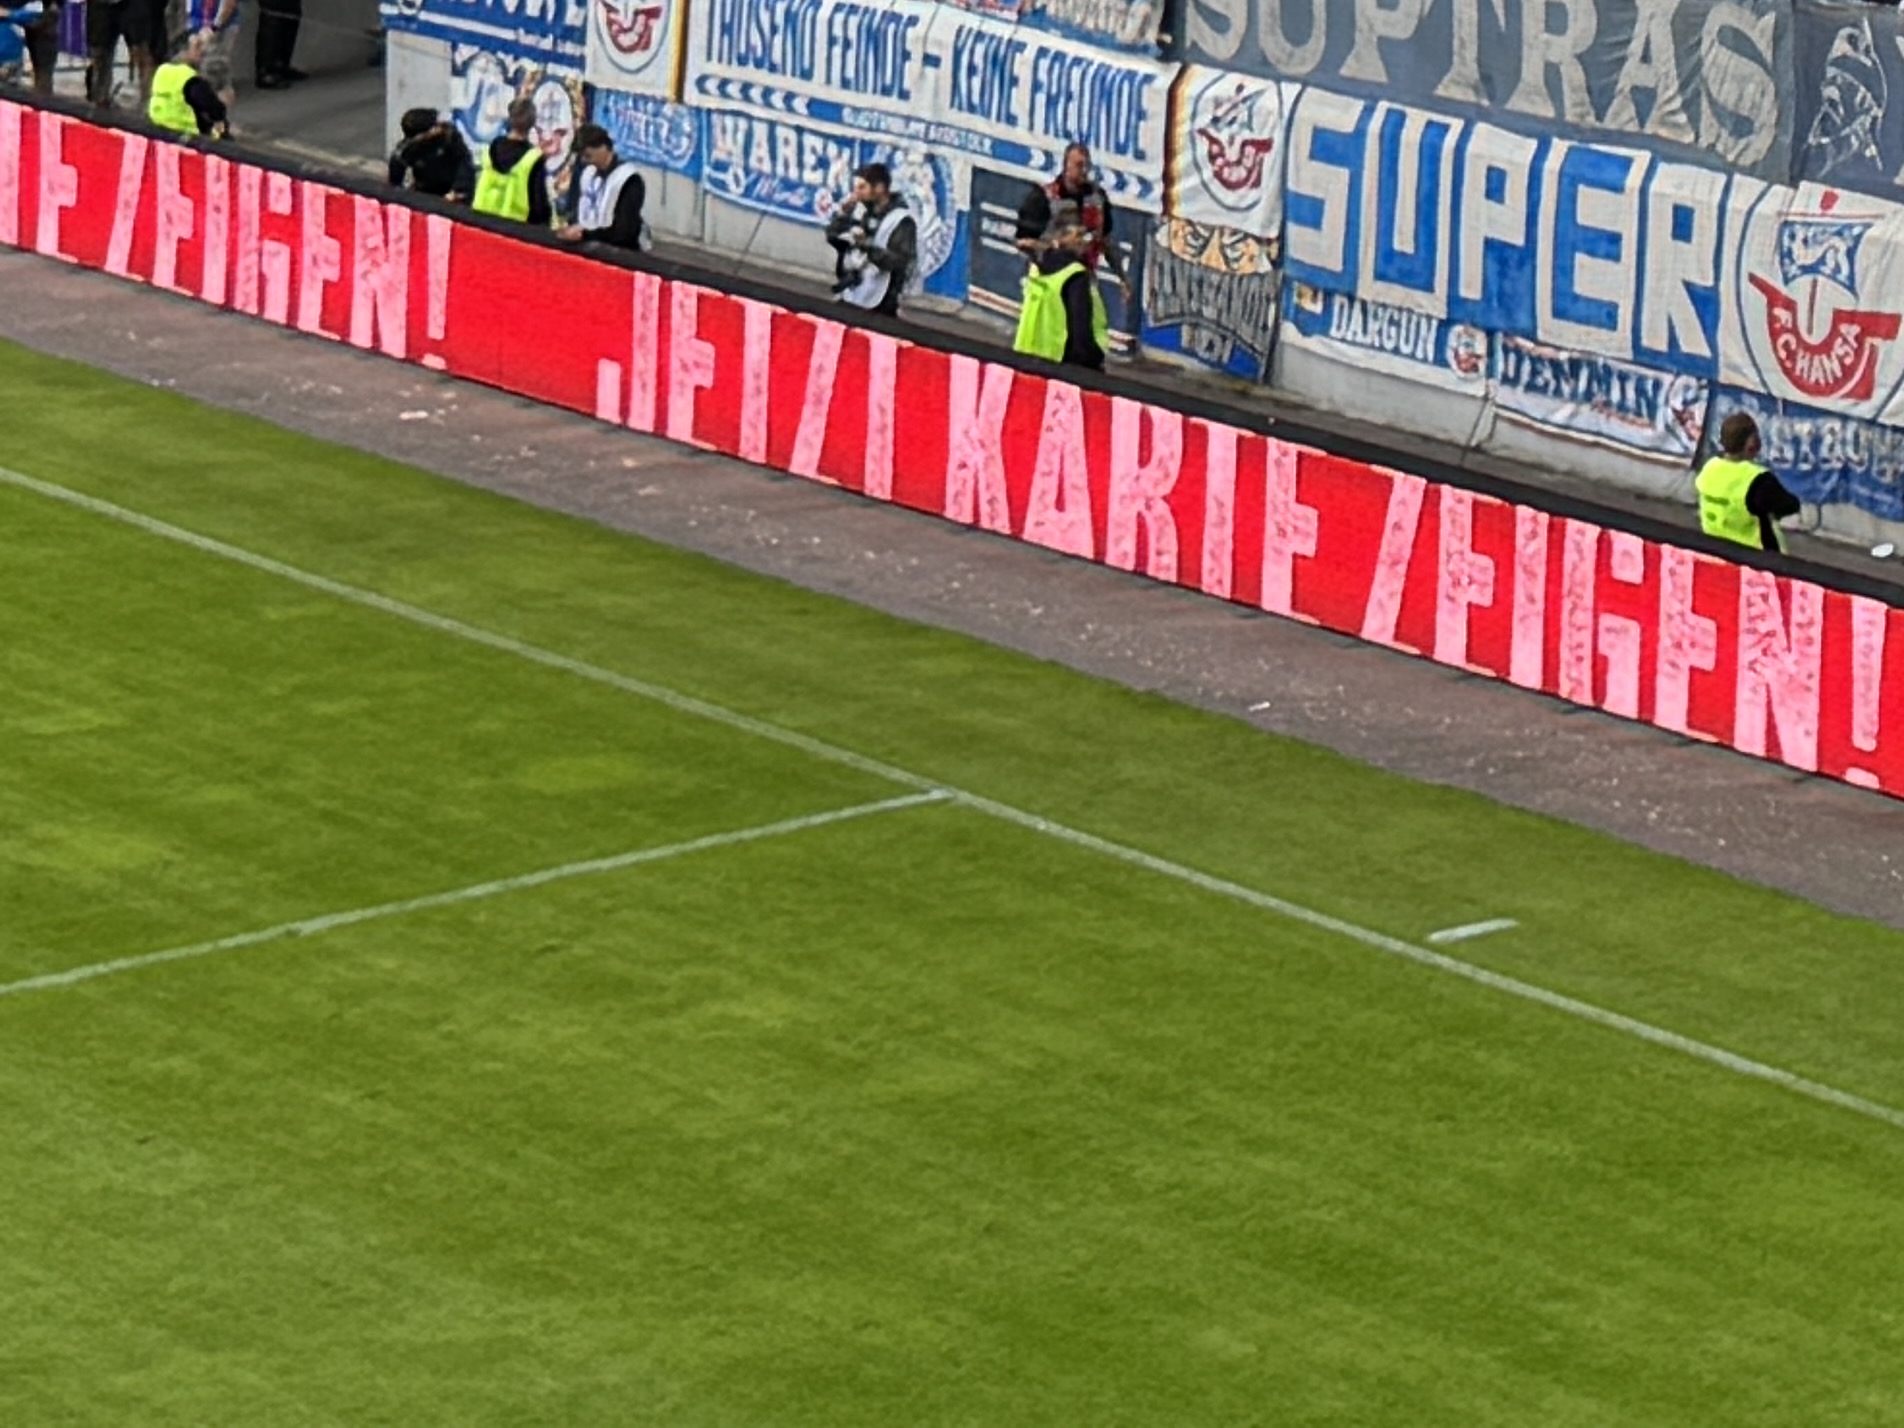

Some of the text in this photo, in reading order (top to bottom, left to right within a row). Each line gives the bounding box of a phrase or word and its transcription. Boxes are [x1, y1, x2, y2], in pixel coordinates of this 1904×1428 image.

[825, 1, 919, 101] FEINDE
[922, 52, 942, 69] -
[950, 23, 1028, 127] KEINE
[1029, 45, 1158, 160] FREUNDE
[1284, 86, 1725, 361] SUPER
[1329, 294, 1439, 363] DARGUN
[1501, 344, 1664, 428] DEMMIN
[1795, 322, 1862, 387] HANSA
[103, 128, 452, 369] ZEIGEN!
[596, 271, 915, 499] JETZT
[946, 356, 1327, 626] KARTE
[1361, 464, 1887, 789] ZEIGEN!
